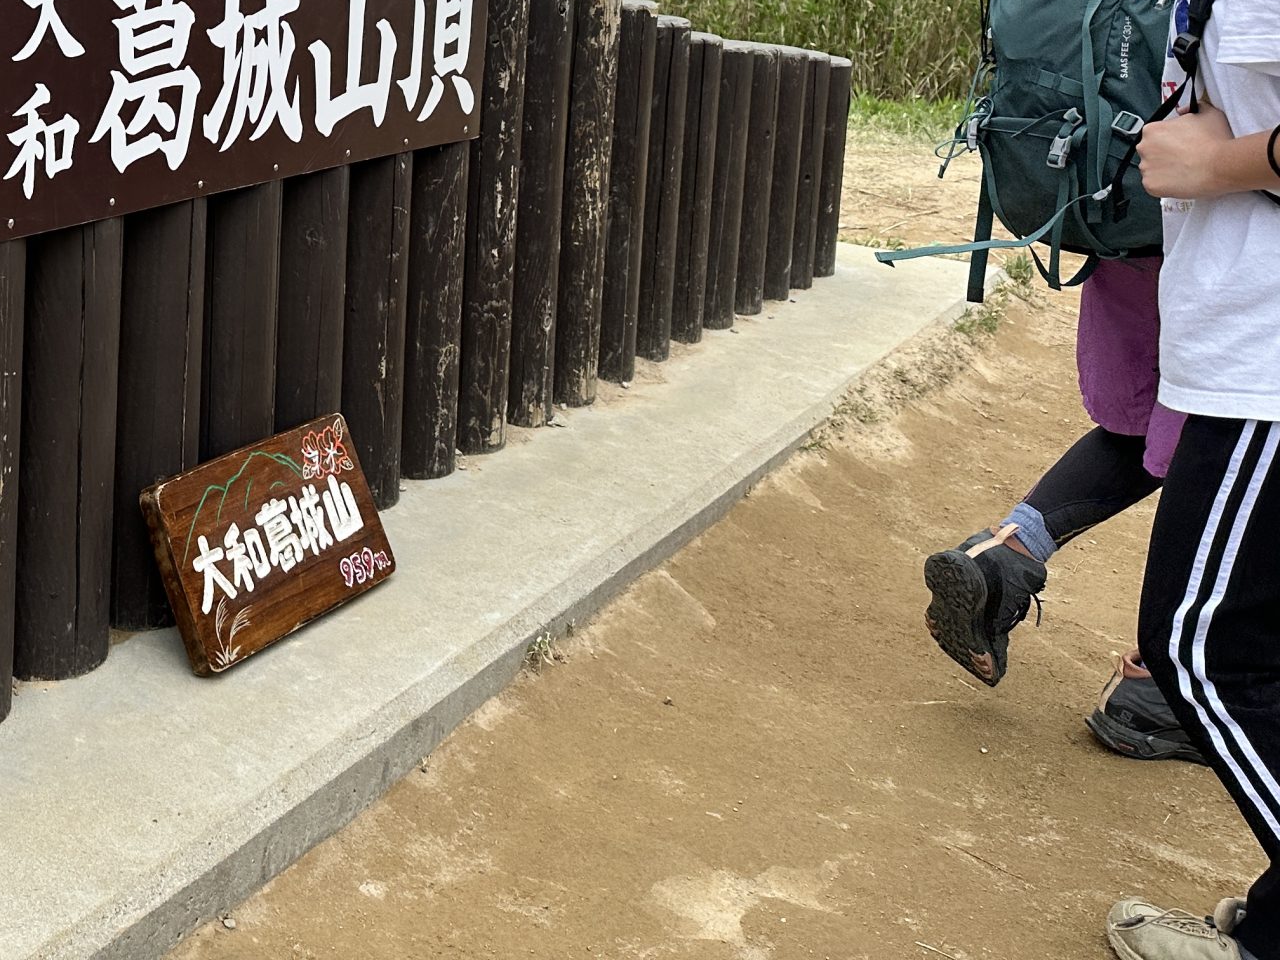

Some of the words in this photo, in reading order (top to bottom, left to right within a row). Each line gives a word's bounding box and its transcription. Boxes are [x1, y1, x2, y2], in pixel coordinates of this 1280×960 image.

[1121, 42, 1130, 57] FEE
[1120, 58, 1129, 79] SAAS
[192, 474, 365, 615] 大和葛城山
